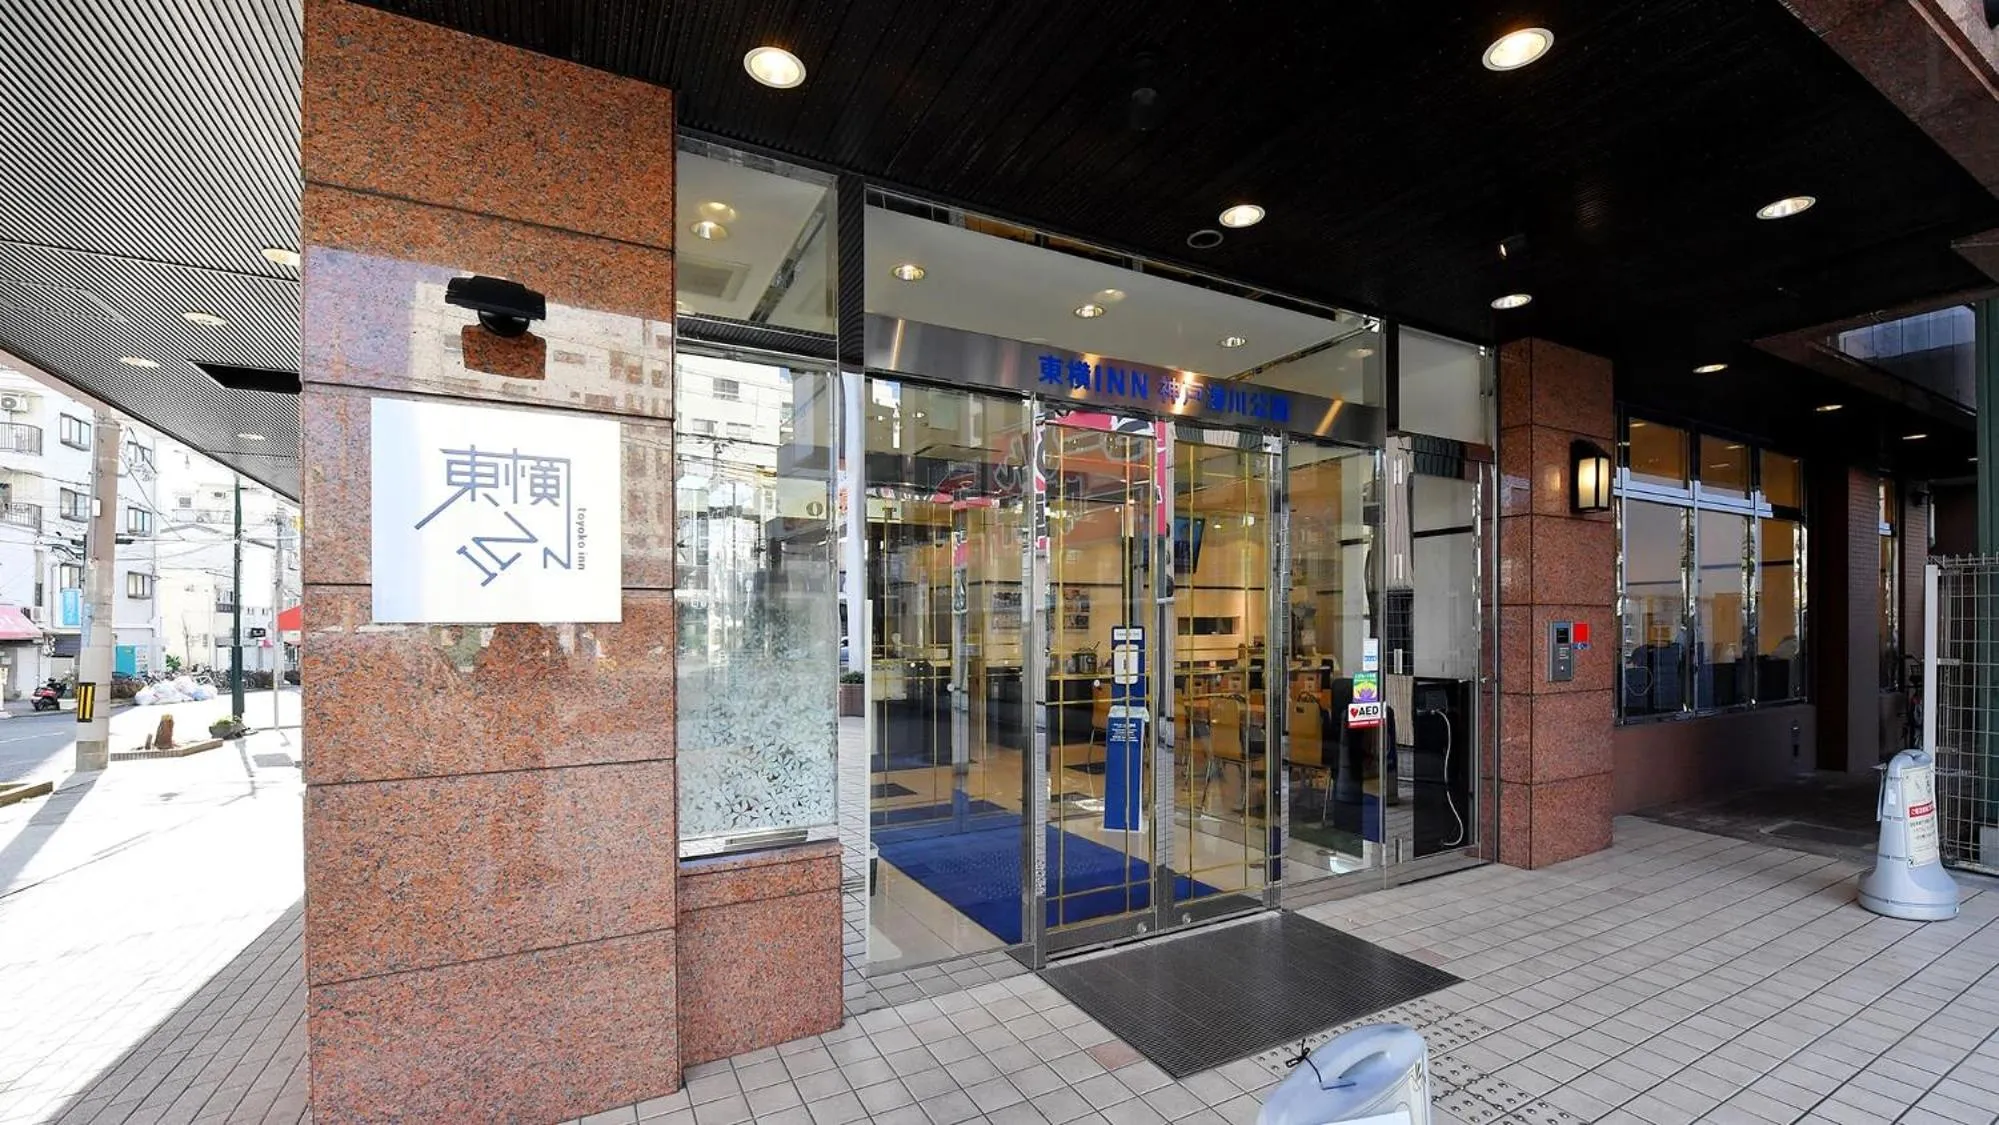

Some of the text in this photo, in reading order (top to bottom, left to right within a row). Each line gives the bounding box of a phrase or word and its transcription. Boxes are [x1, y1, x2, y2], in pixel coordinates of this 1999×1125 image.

[1038, 355, 1148, 400] 東横INN
[575, 507, 587, 571] toyoko inn
[1358, 706, 1378, 715] AED
